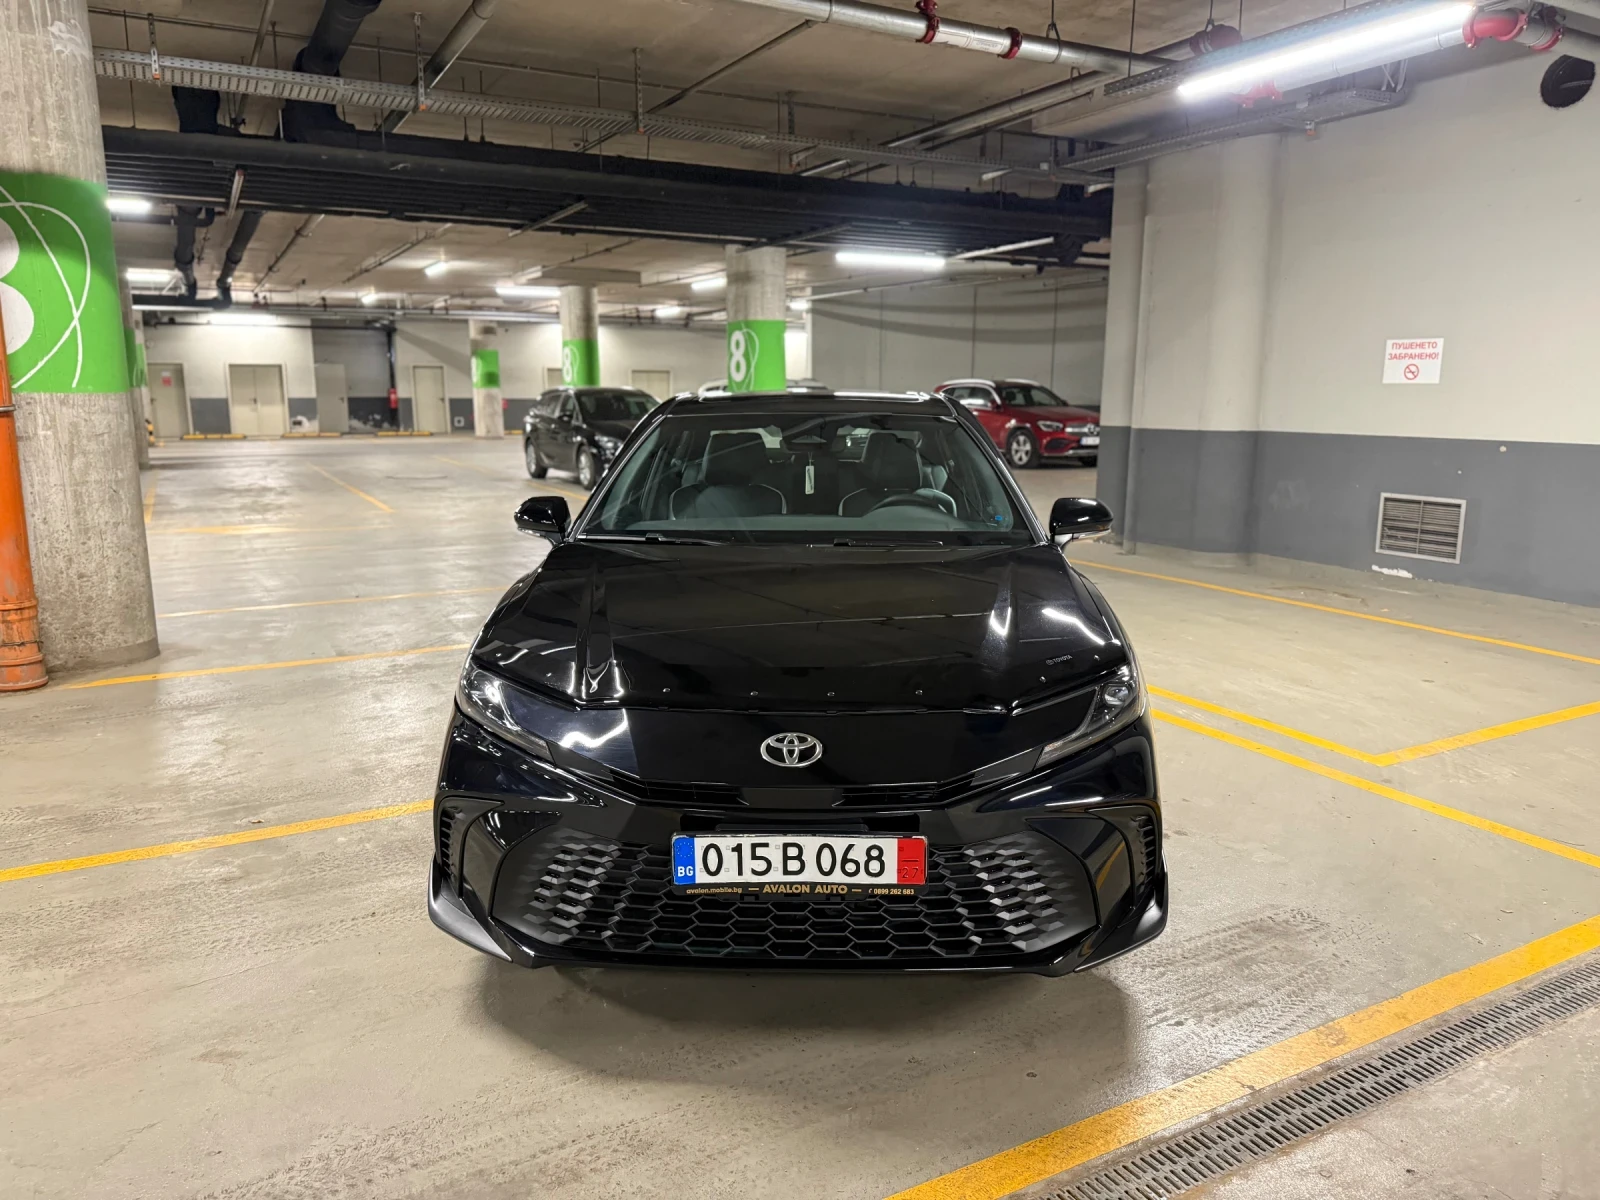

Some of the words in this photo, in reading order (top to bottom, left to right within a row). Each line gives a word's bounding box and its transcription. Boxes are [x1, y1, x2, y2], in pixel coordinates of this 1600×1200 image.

[1391, 341, 1438, 350] ПУШЕНЕТО
[730, 330, 747, 383] 8
[1387, 352, 1440, 361] ЗАБРАНЕНО!
[563, 346, 573, 383] 8
[702, 842, 772, 877] 015
[782, 842, 806, 876] B
[815, 842, 886, 878] 068
[677, 866, 694, 877] BG
[902, 866, 919, 879] 27
[686, 886, 743, 895] avalon.mobile.bg
[762, 884, 810, 894] AVALON
[815, 884, 848, 895] AUTO
[873, 888, 889, 896] 0899
[889, 888, 902, 896] 262
[902, 888, 915, 896] 683
